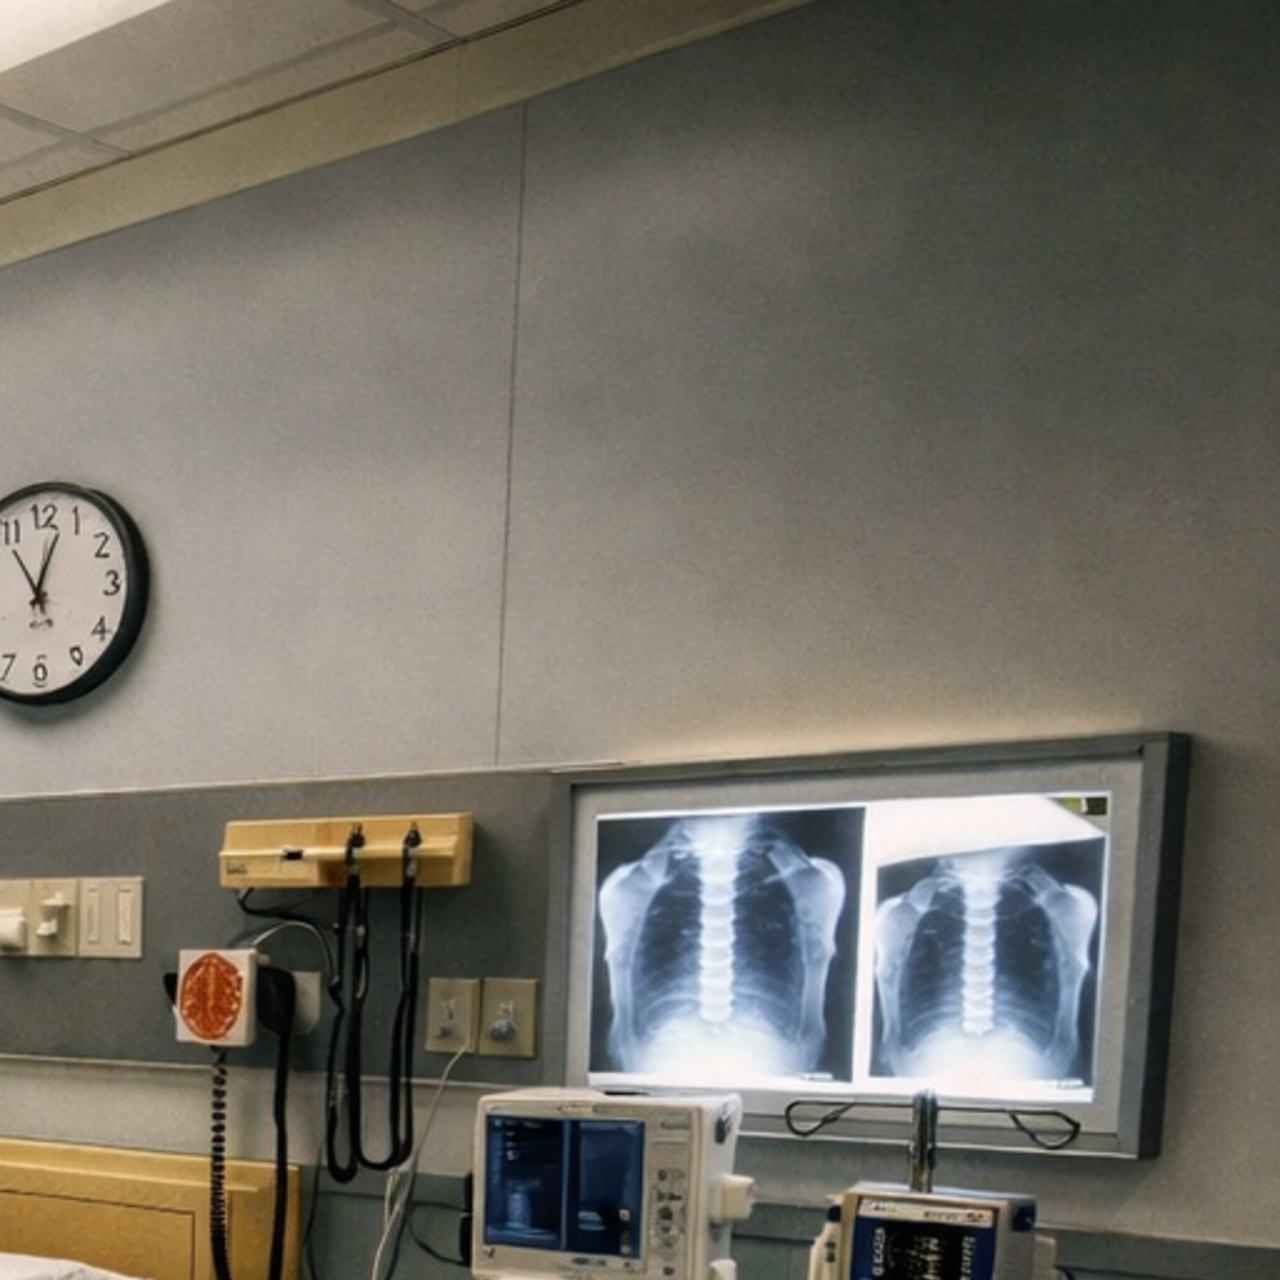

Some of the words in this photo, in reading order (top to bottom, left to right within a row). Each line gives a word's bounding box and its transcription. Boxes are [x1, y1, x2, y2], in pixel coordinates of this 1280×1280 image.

[30, 503, 59, 531] 12
[72, 505, 81, 536] 1
[1, 518, 21, 546] 11
[94, 531, 111, 559] 2
[103, 569, 122, 597] 3
[91, 615, 112, 642] 4
[0, 653, 17, 682] 7
